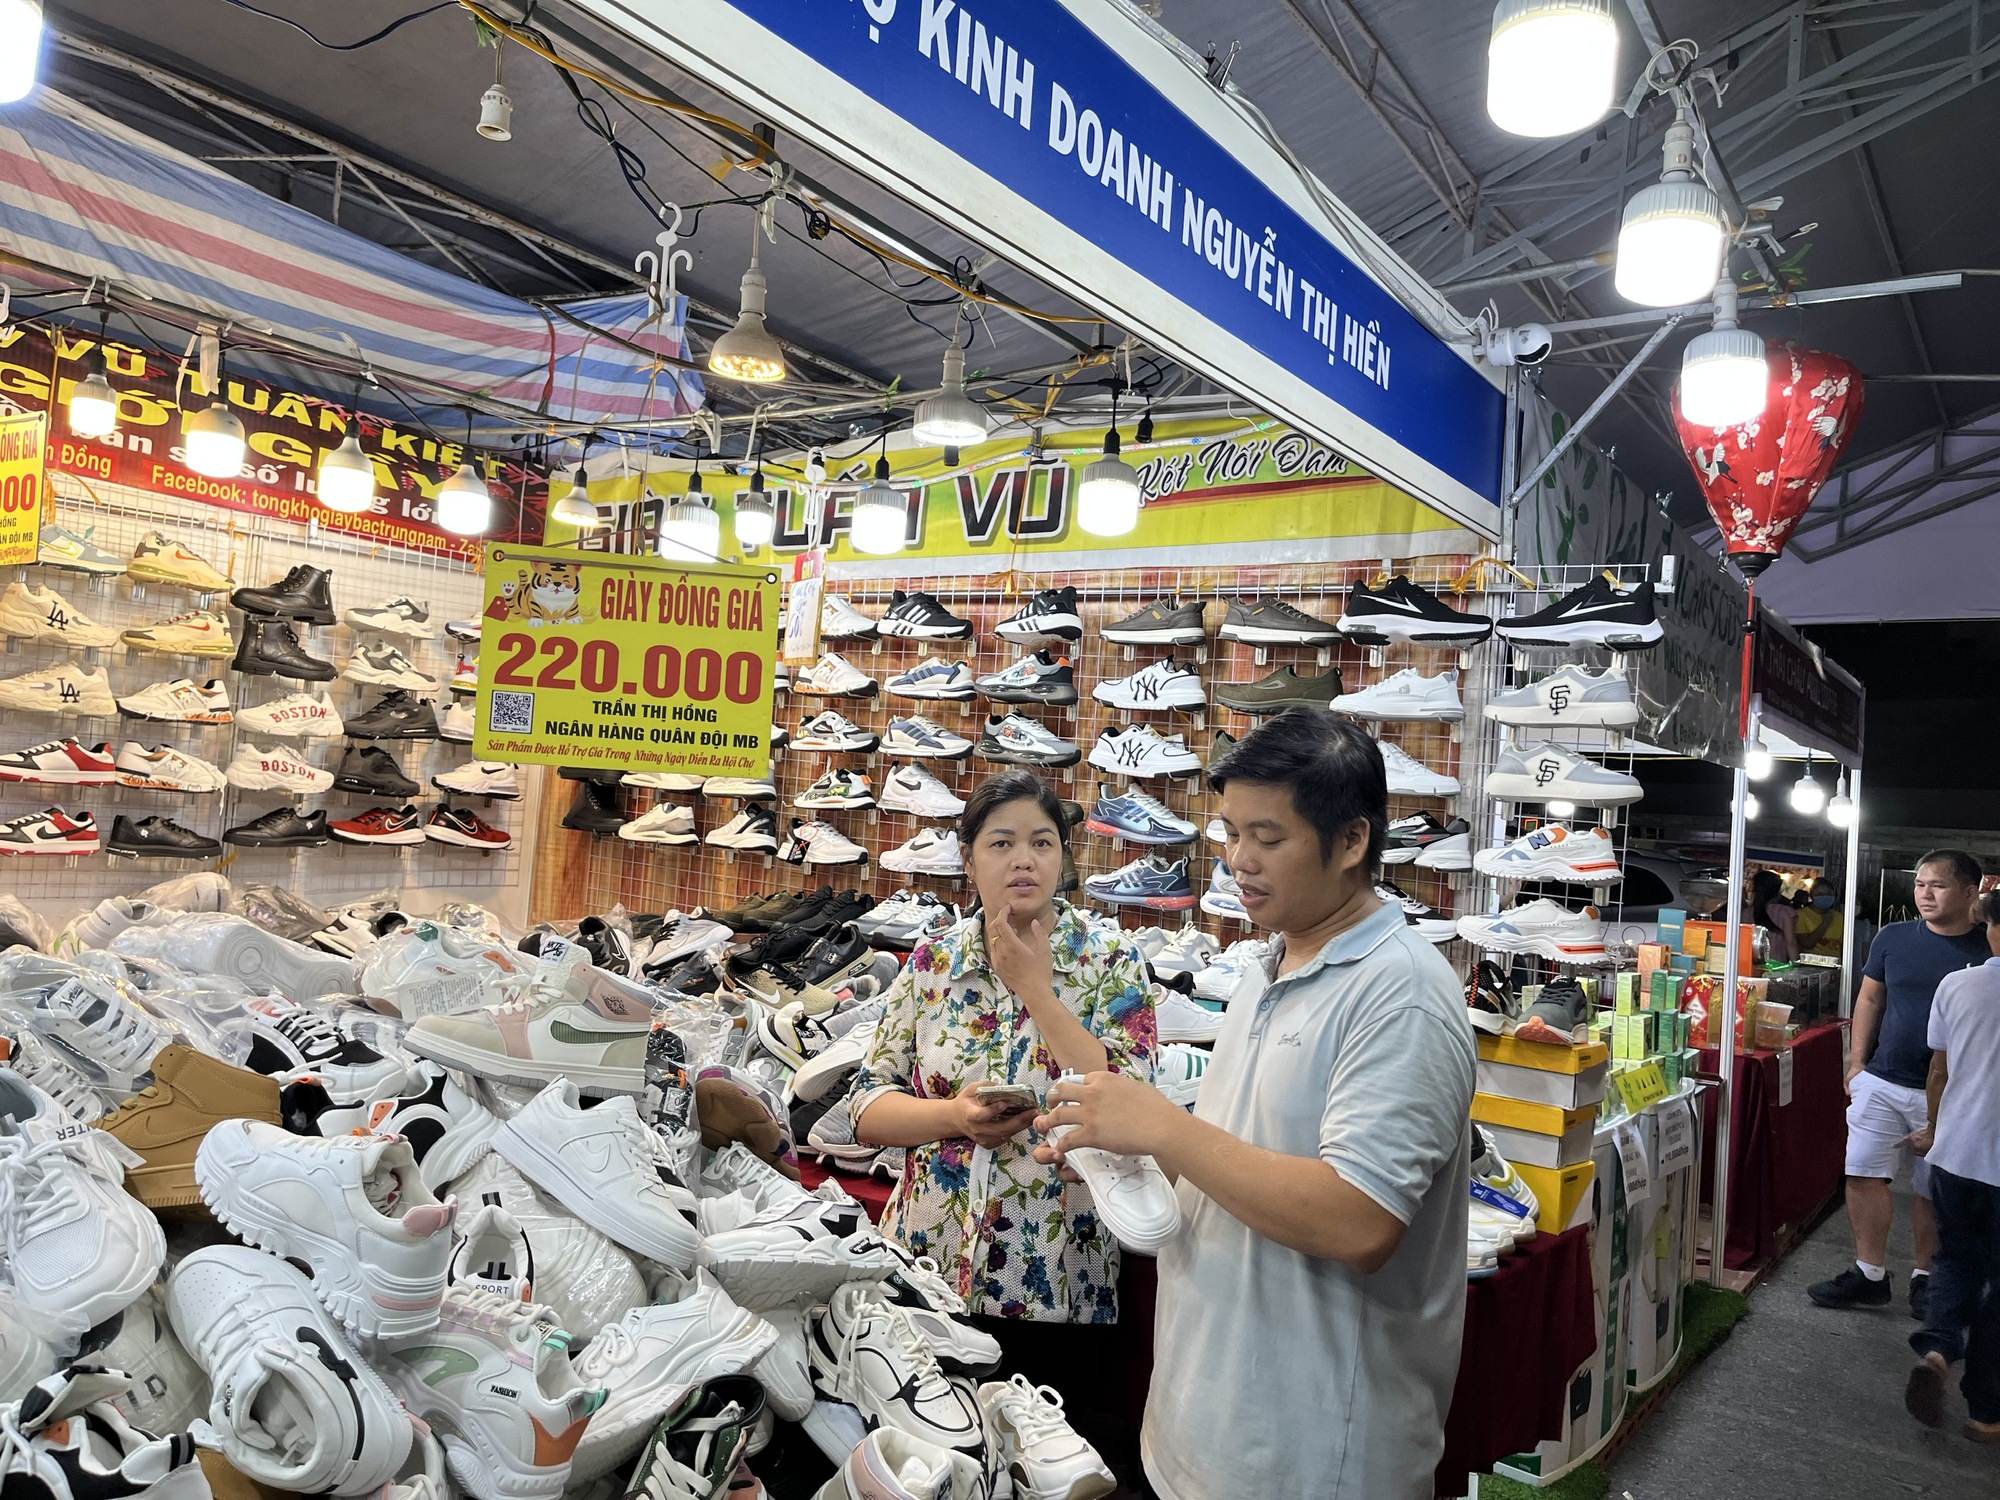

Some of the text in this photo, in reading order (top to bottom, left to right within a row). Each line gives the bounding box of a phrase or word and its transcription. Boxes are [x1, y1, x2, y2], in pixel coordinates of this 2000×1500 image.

[919, 0, 1391, 391] KINH DOANH NGUYỄN THỊ HIỀN
[45, 329, 147, 377] VŨ
[0, 425, 19, 462] ỒNG
[22, 425, 38, 460] GIÁ
[61, 444, 112, 479] Đồng
[151, 464, 247, 504] Facebook:
[1137, 454, 1192, 506] Kết
[1199, 440, 1268, 484] Nối
[955, 455, 1069, 542] VŨ
[47, 599, 69, 631] LA
[600, 571, 653, 623] GIÀY
[658, 573, 720, 628] ĐỒNG
[727, 582, 764, 632] GIÁ
[494, 632, 763, 705] 220.000
[57, 677, 81, 704] LA
[269, 706, 327, 723] BOSTON
[592, 697, 718, 723] TRẦN THỊ HỒNG
[545, 719, 759, 749] NGÂN HÀNG QUÂN ĐỘI MB
[261, 760, 316, 781] BOSTON
[605, 747, 632, 762] Trong
[664, 752, 687, 767] Ngày
[709, 755, 721, 766] Ra
[475, 1284, 510, 1295] SPORT
[490, 1384, 519, 1399] FASHION
